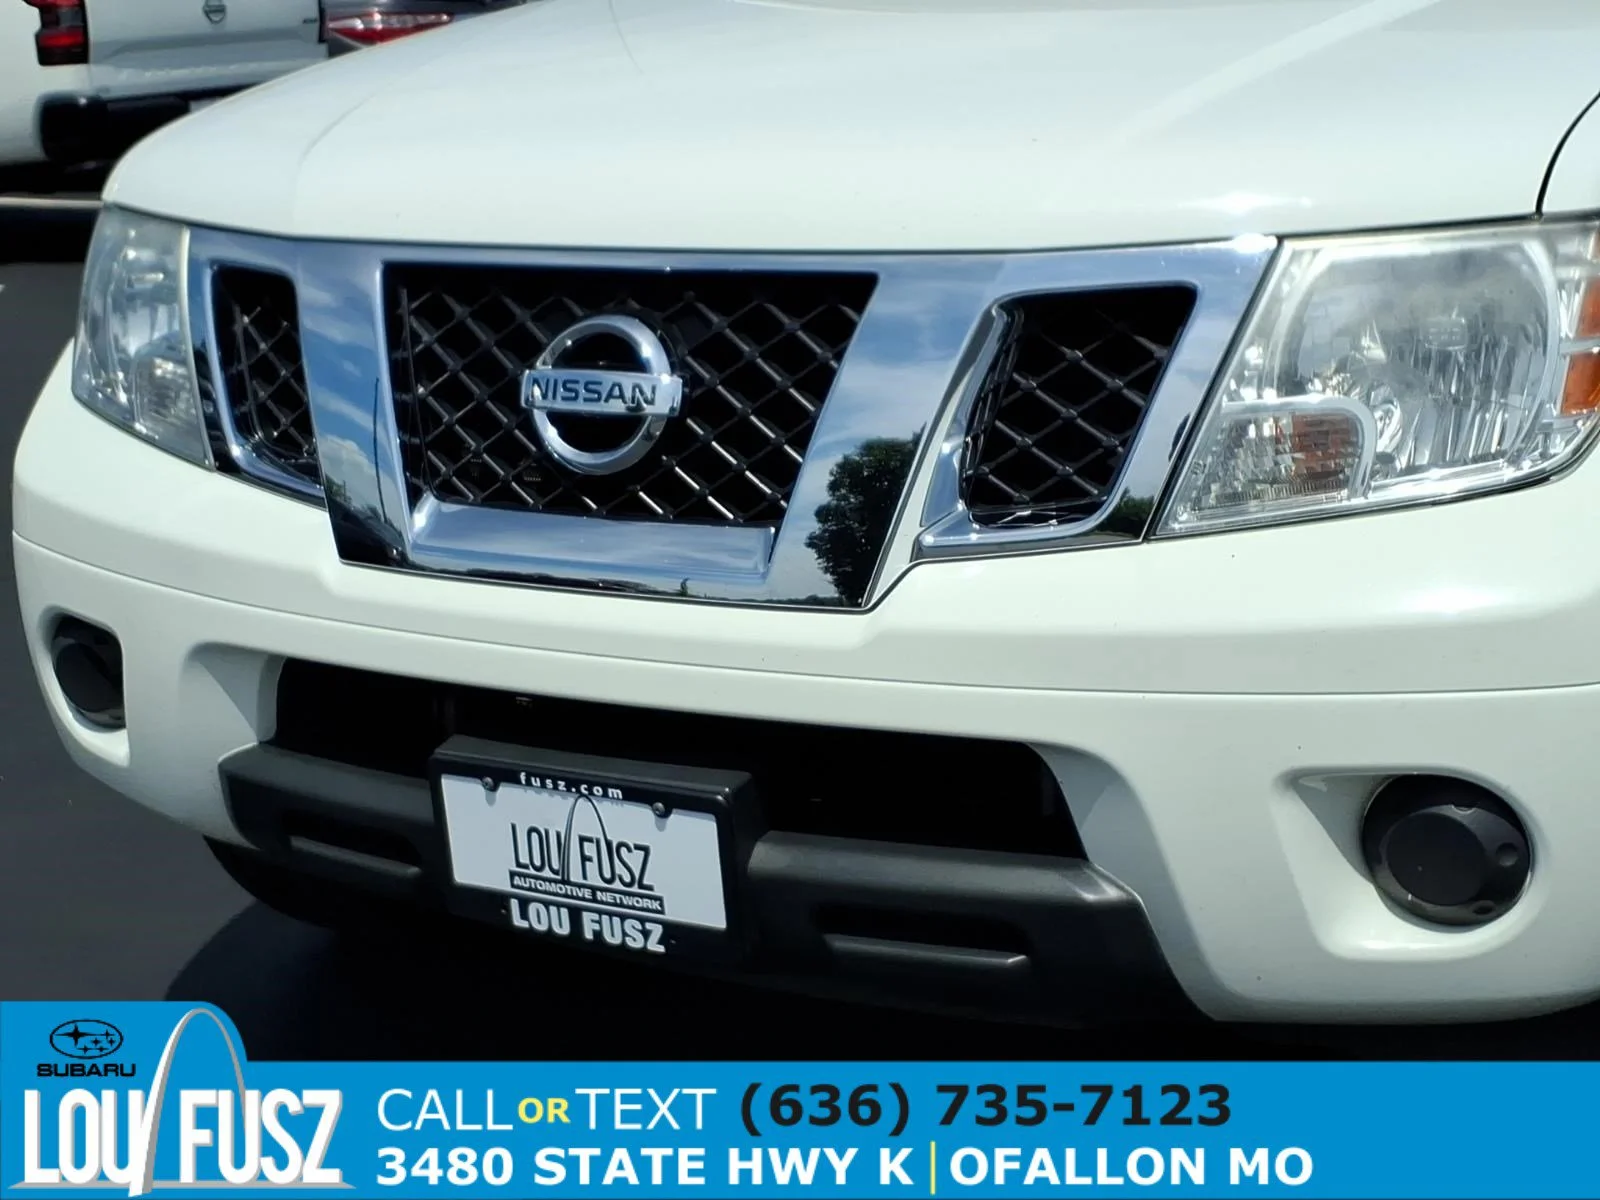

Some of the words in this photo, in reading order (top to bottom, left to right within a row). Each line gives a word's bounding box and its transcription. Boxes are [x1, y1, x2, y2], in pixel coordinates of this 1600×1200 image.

[530, 377, 657, 406] NISSAN
[519, 771, 623, 799] fusz.com
[510, 822, 563, 875] LOU
[578, 833, 655, 892] FUSZ
[513, 875, 593, 899] AUTOMOTIVE
[597, 891, 662, 911] NETWORK
[510, 898, 571, 936] LOU
[583, 911, 666, 952] FUSZ
